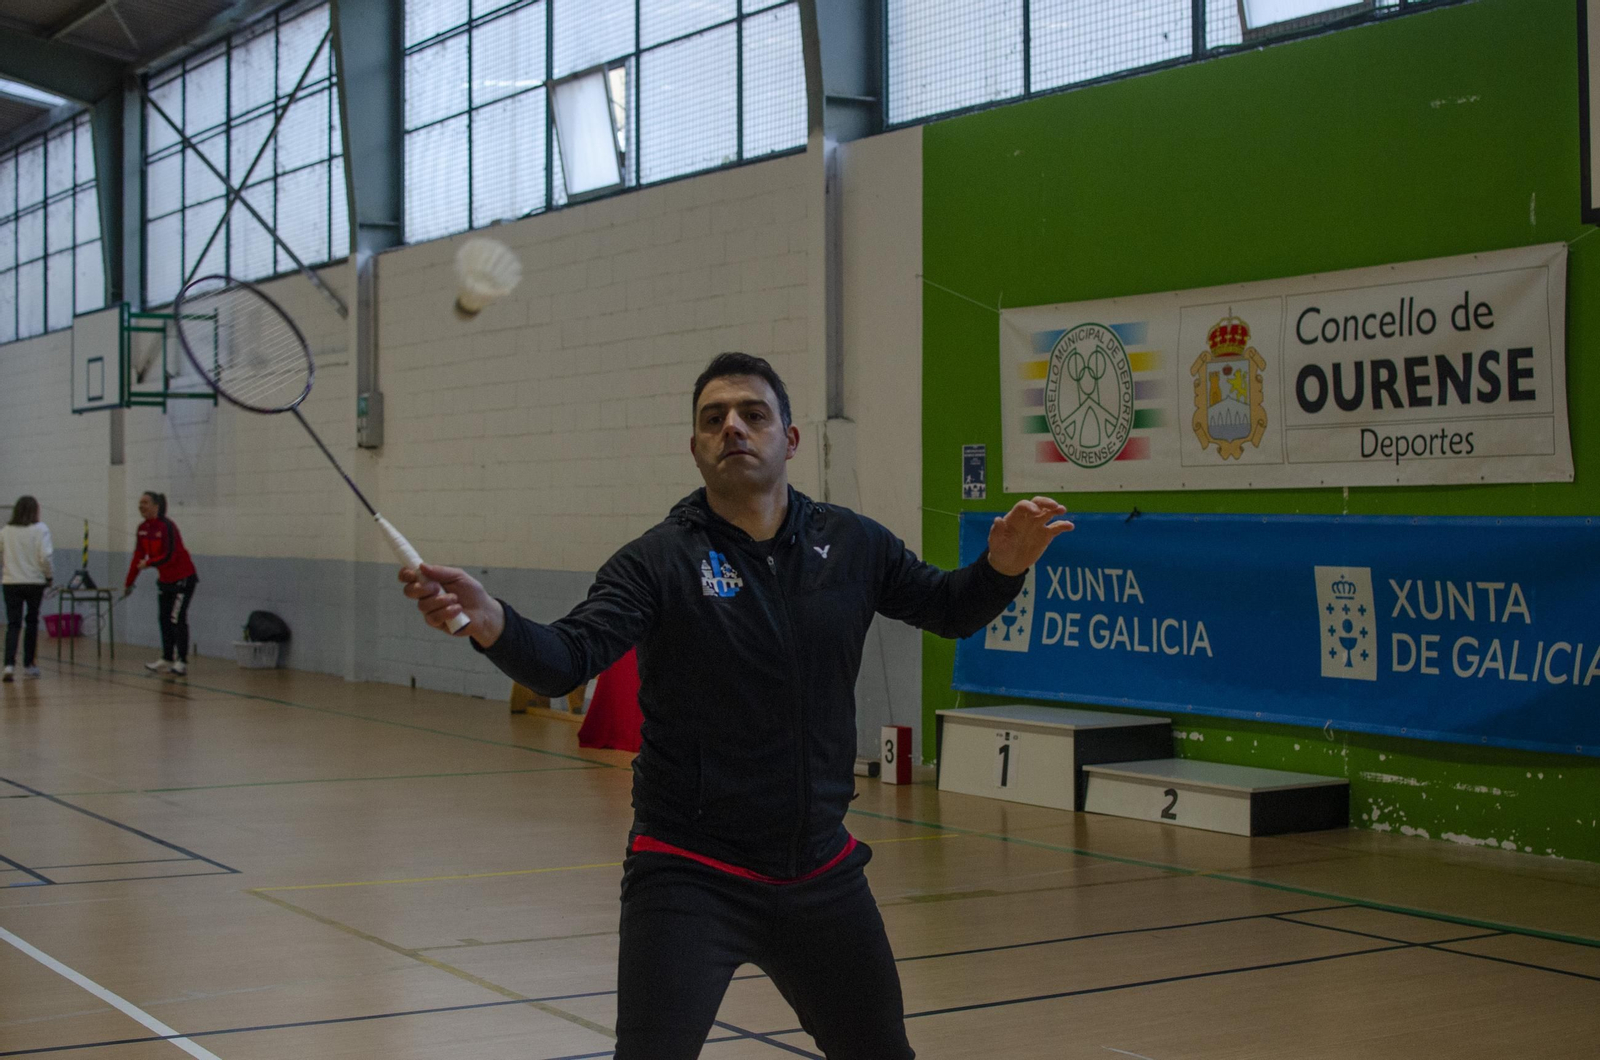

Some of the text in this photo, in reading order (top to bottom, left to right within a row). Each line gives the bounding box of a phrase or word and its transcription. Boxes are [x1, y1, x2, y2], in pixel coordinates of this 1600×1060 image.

[1296, 290, 1495, 345] Concello de
[1048, 328, 1132, 445] CONSELLO MUNICIPAL DE DEPORTES
[1295, 347, 1537, 414] OURENSE
[1067, 442, 1115, 464] OURENSE
[1360, 427, 1475, 466] Deportes
[1046, 566, 1144, 604] XUNTA
[1388, 579, 1532, 624] XUNTA
[1041, 612, 1213, 657] DE GALICIA
[1391, 632, 1441, 675] DE
[885, 739, 894, 764] 3
[999, 744, 1010, 787] 1
[1160, 788, 1179, 820] 2
